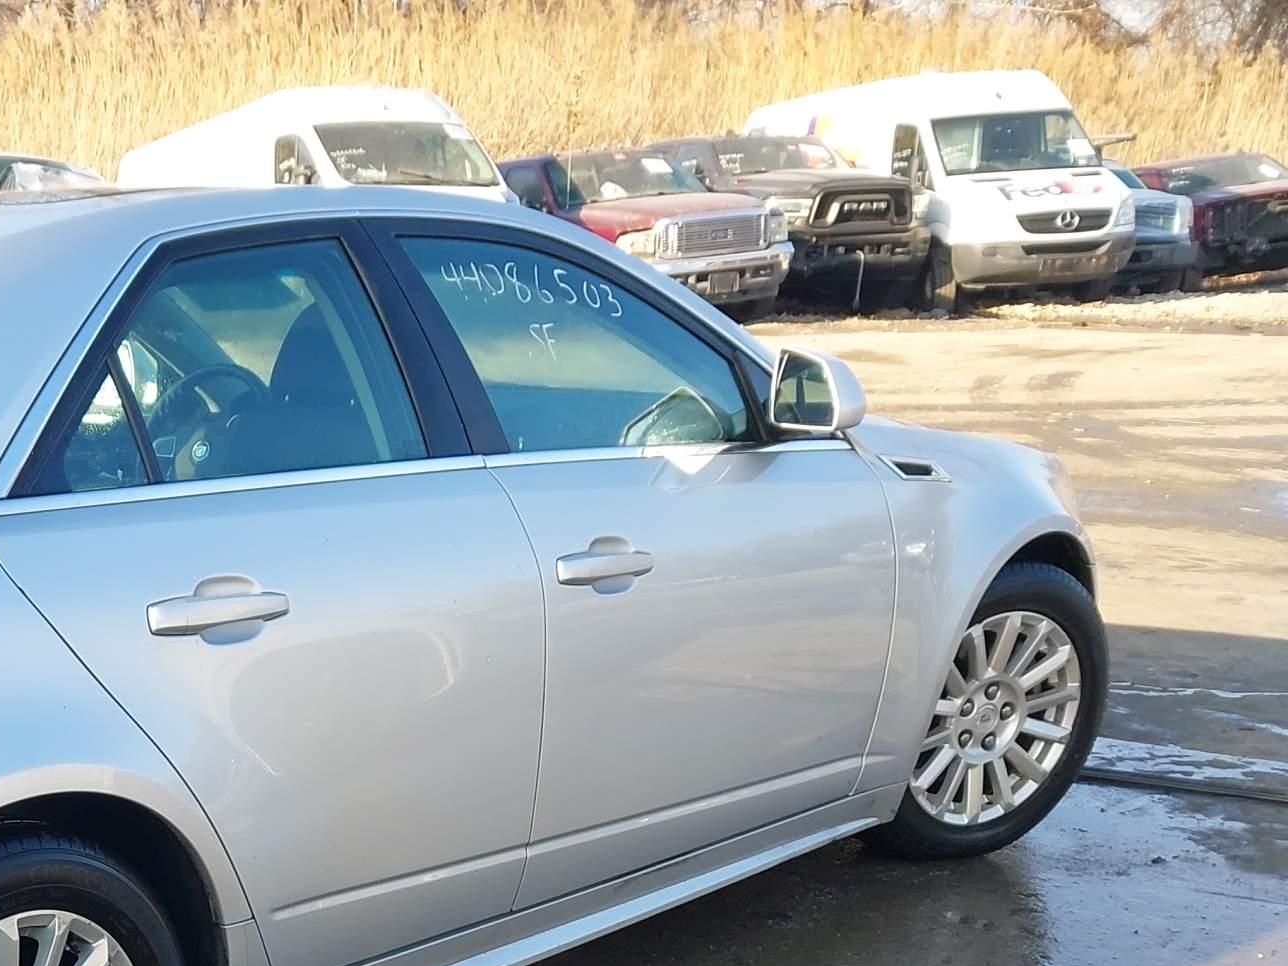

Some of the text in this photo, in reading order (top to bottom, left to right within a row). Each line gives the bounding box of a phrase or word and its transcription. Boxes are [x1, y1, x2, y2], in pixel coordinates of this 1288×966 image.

[997, 180, 1103, 201] Fed
[843, 201, 888, 213] RAM
[441, 262, 623, 317] 44086503
